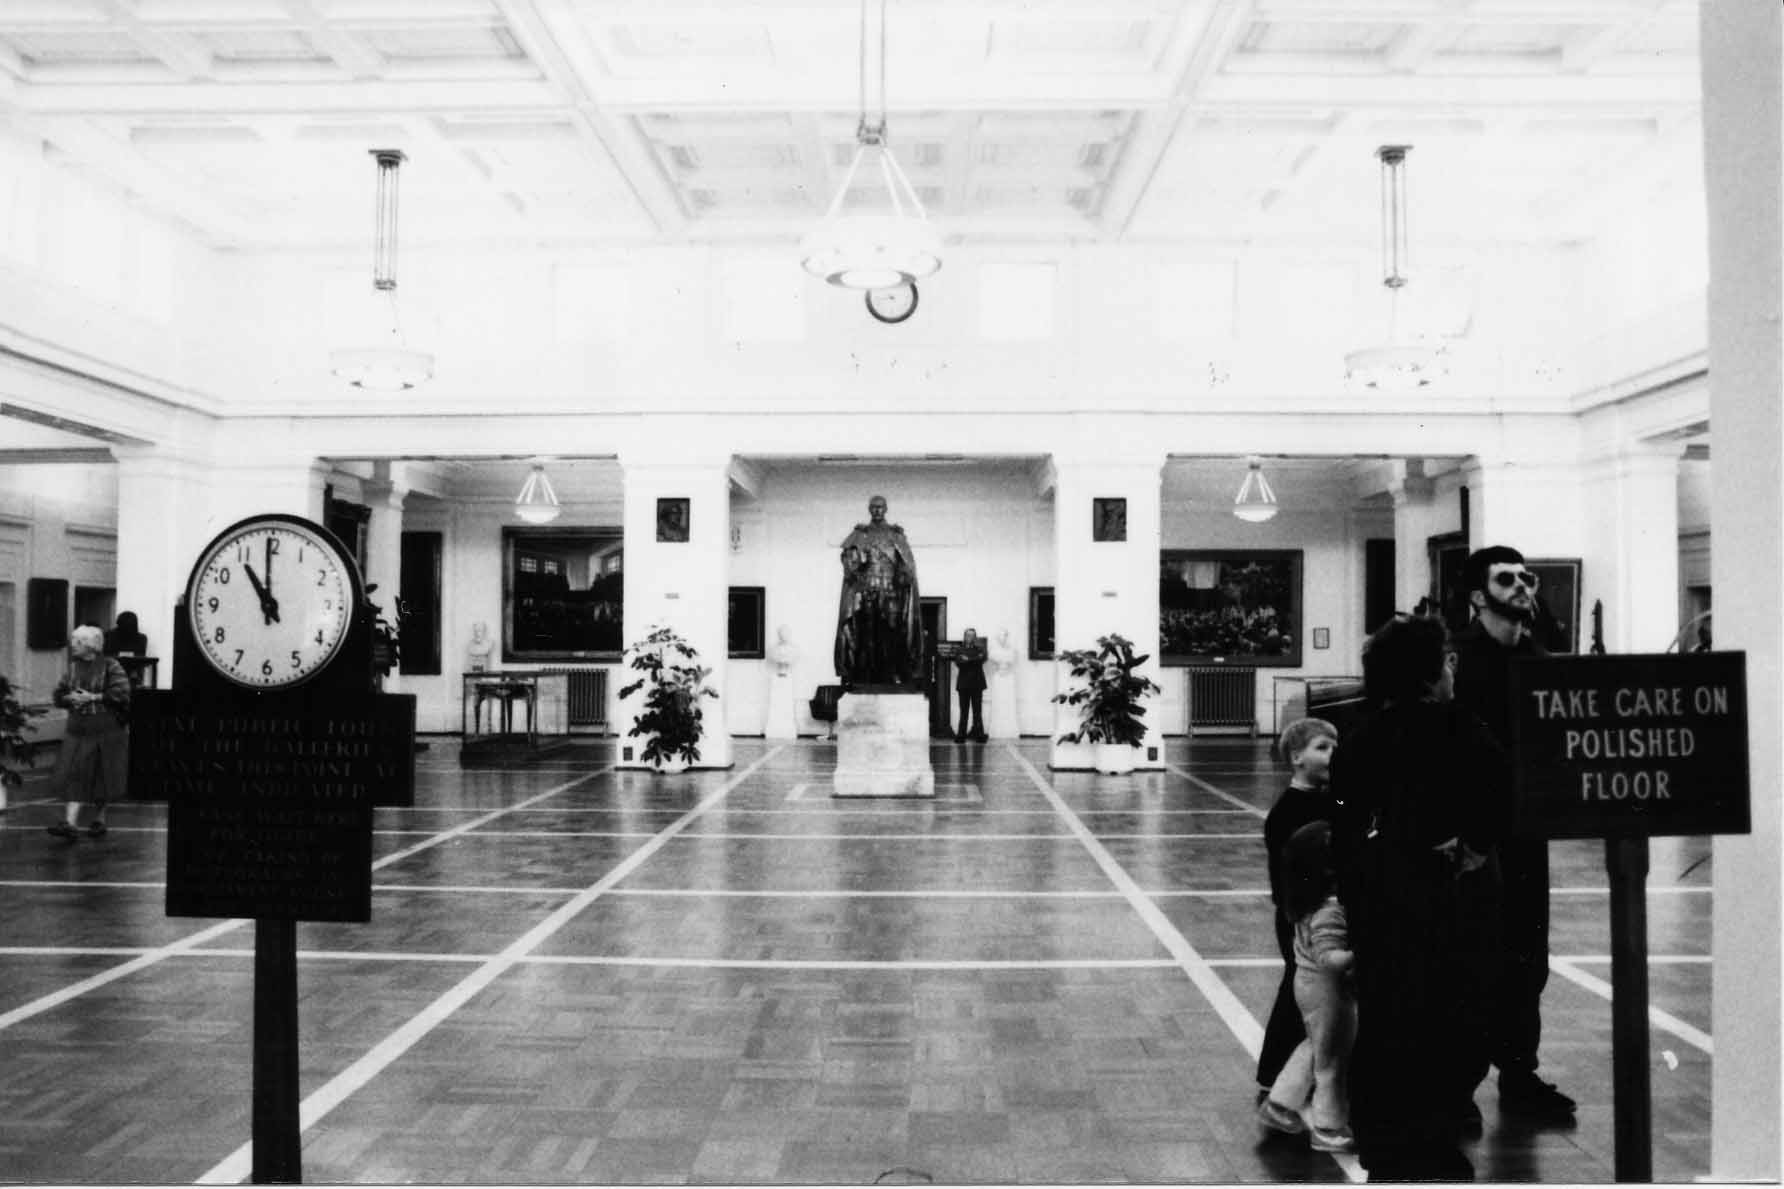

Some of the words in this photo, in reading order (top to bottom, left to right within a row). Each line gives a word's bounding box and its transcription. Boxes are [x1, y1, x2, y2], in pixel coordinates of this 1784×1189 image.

[238, 546, 250, 563] 11
[299, 546, 303, 563] 1
[213, 567, 230, 584] 10
[317, 569, 327, 587] 2
[208, 597, 220, 614] 9
[214, 627, 225, 644] 8
[314, 629, 325, 646] 4
[234, 649, 245, 666] 7
[290, 650, 302, 668] 5
[261, 659, 273, 676] 6
[1532, 689, 1600, 719] TAKE
[1615, 688, 1684, 717] CARE
[1694, 686, 1728, 715] ON
[263, 739, 390, 758] GALLERIE
[1566, 728, 1695, 759] POLISHED
[1581, 771, 1671, 801] FLOOR
